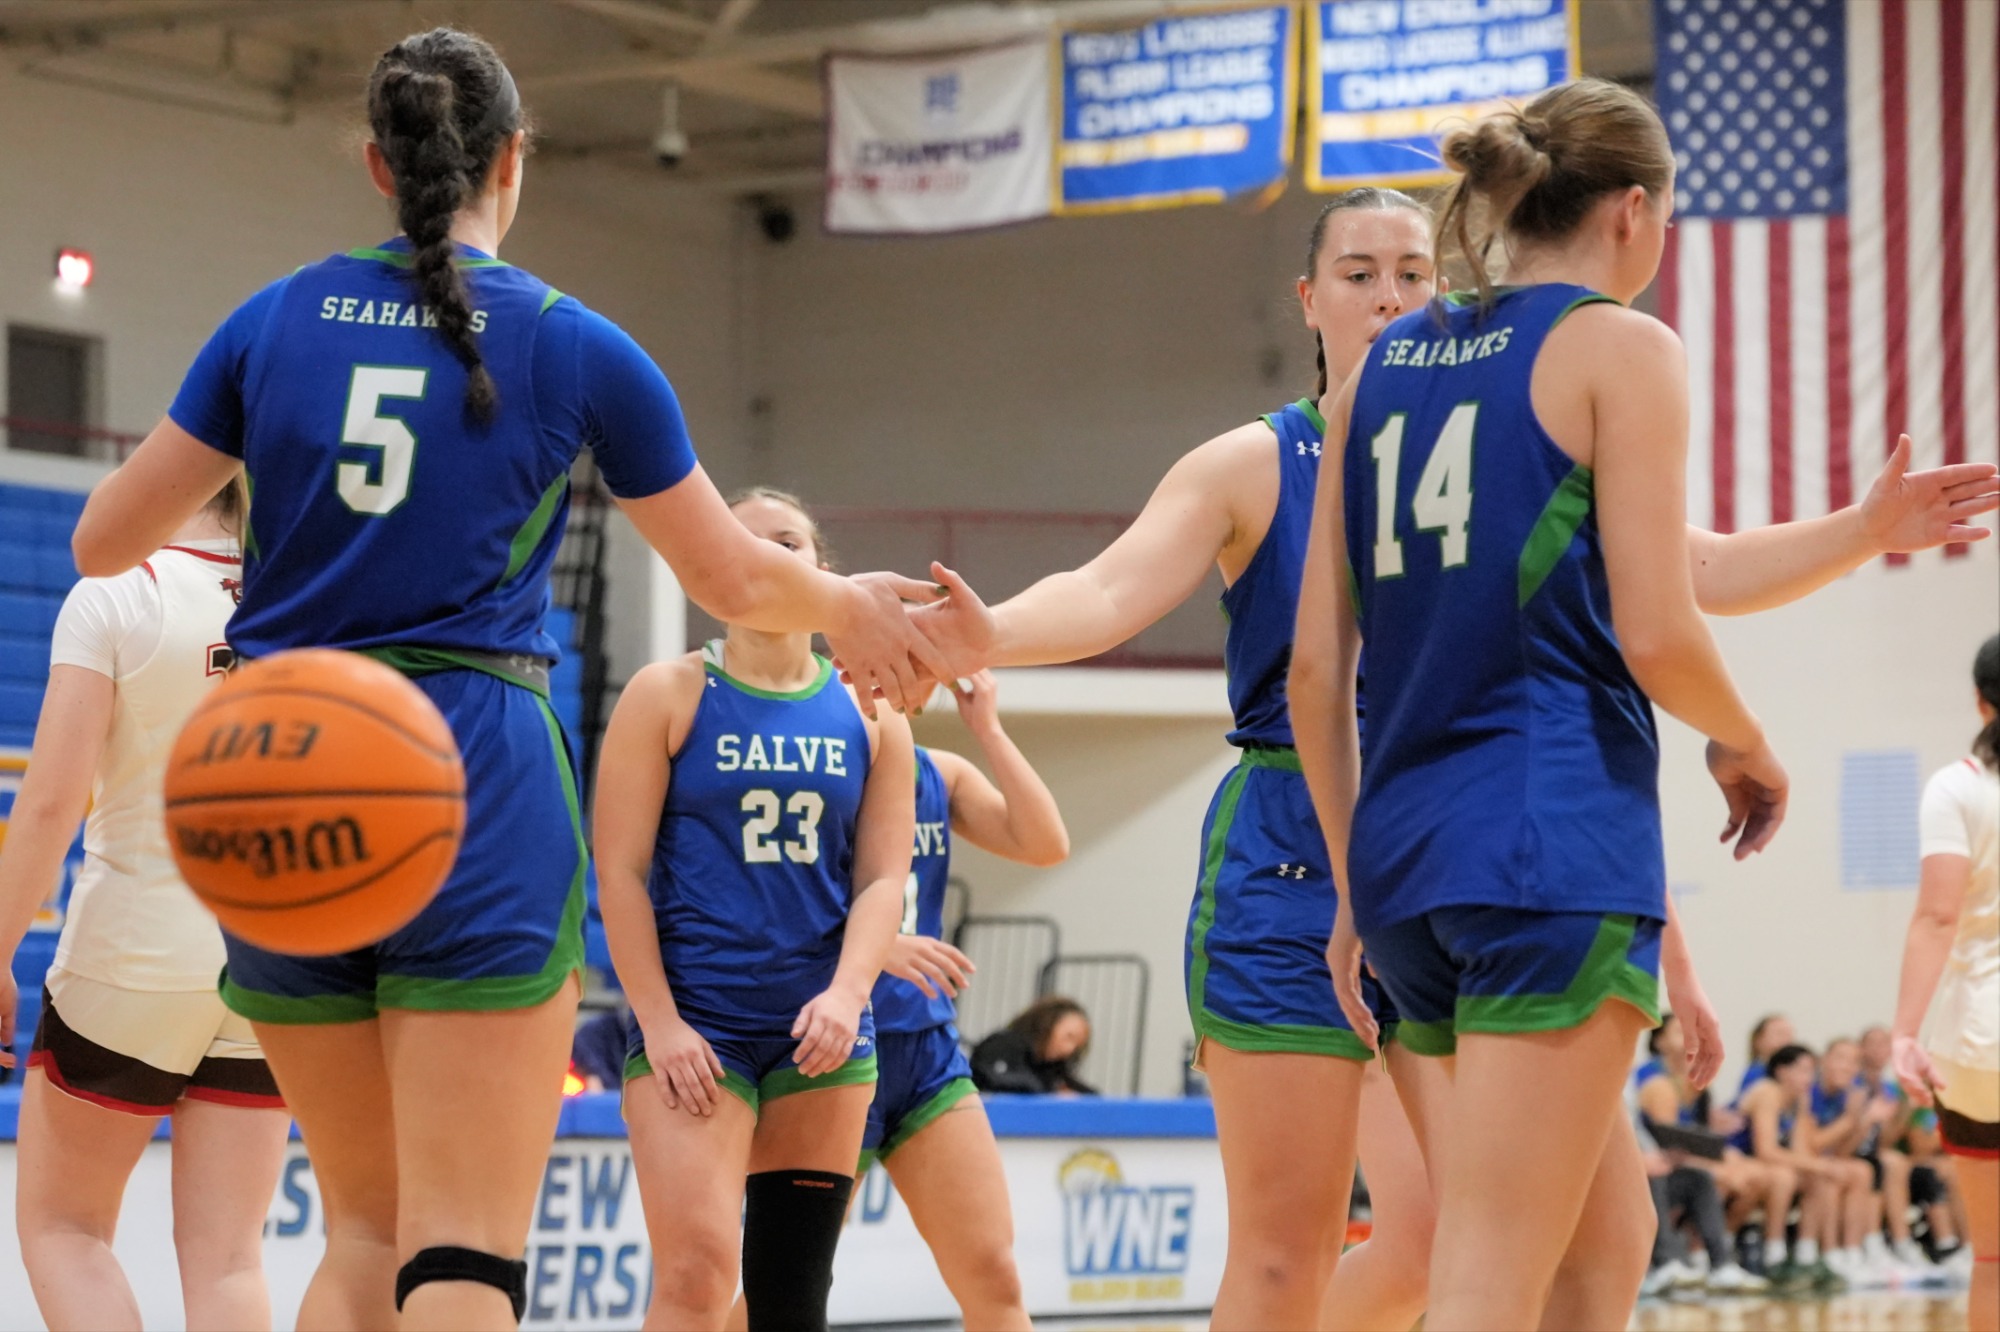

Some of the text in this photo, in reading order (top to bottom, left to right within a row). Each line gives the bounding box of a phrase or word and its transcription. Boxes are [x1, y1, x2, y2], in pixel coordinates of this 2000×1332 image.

[320, 296, 489, 333] SEAHAWS
[335, 362, 430, 518] 5
[1371, 400, 1481, 582] 14
[716, 734, 847, 777] SALVE
[174, 816, 369, 881] Wilson
[741, 789, 824, 864] 23
[537, 1156, 631, 1230] EW
[1063, 1186, 1195, 1275] WNE
